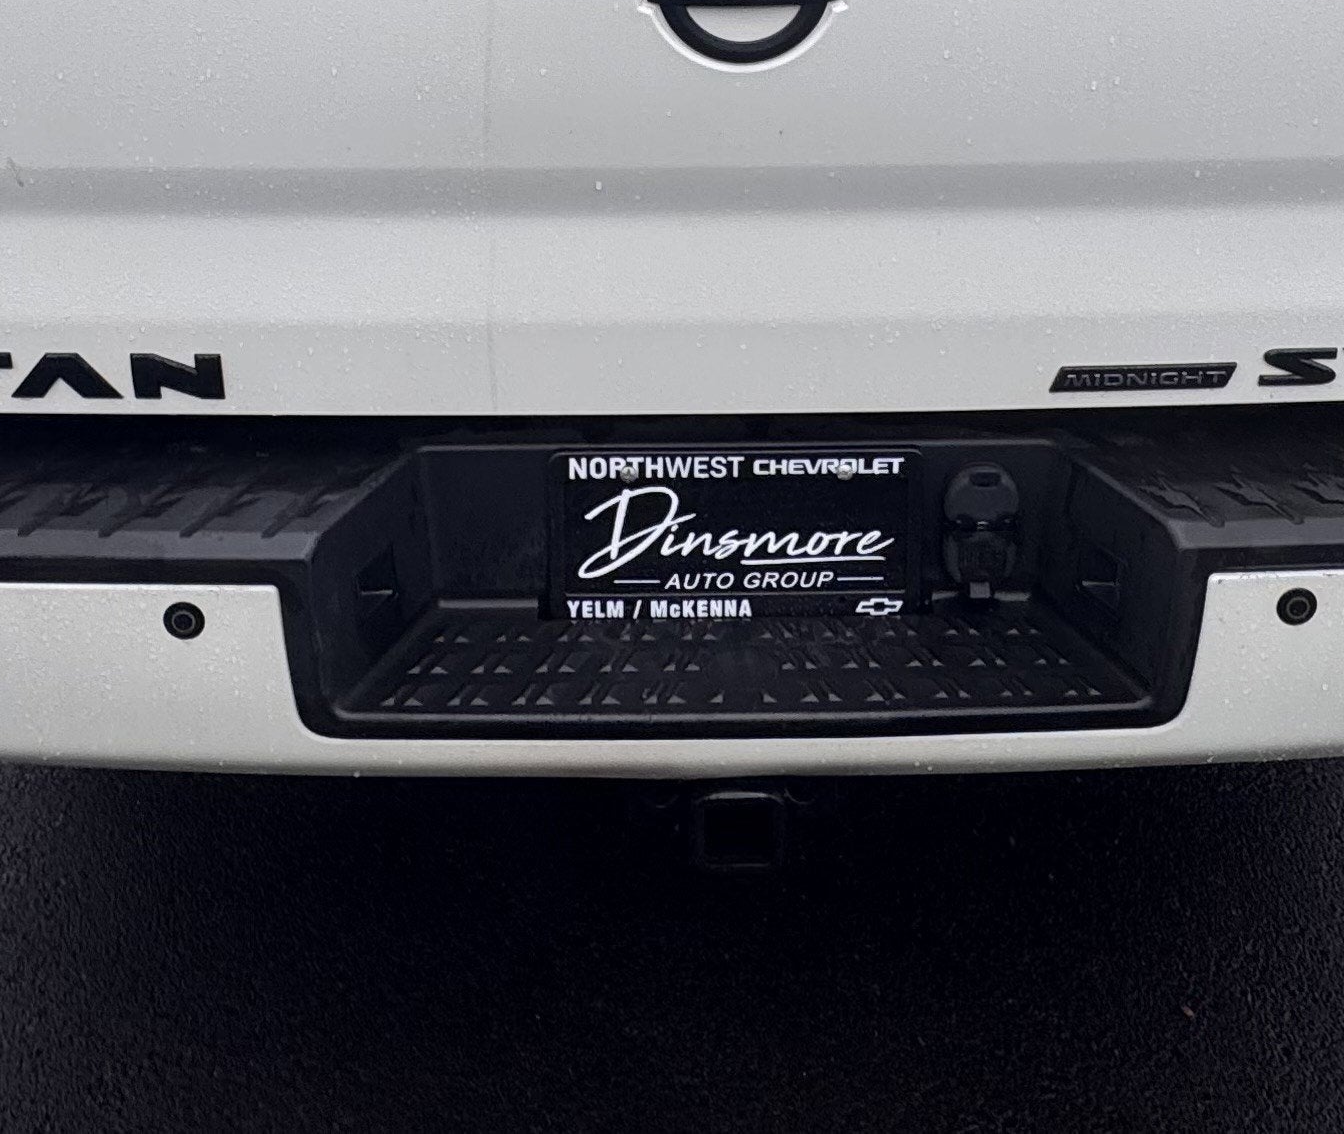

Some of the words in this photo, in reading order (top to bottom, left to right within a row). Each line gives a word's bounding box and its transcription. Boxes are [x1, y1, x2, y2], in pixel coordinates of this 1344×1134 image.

[568, 456, 744, 479] NORTHWEST
[752, 457, 905, 477] CHEVROLET
[578, 486, 895, 579] Dinsmore
[664, 572, 735, 590] AUTO
[743, 571, 835, 589] GROUP
[567, 600, 625, 619] YELM
[650, 600, 752, 618] McKENNA
